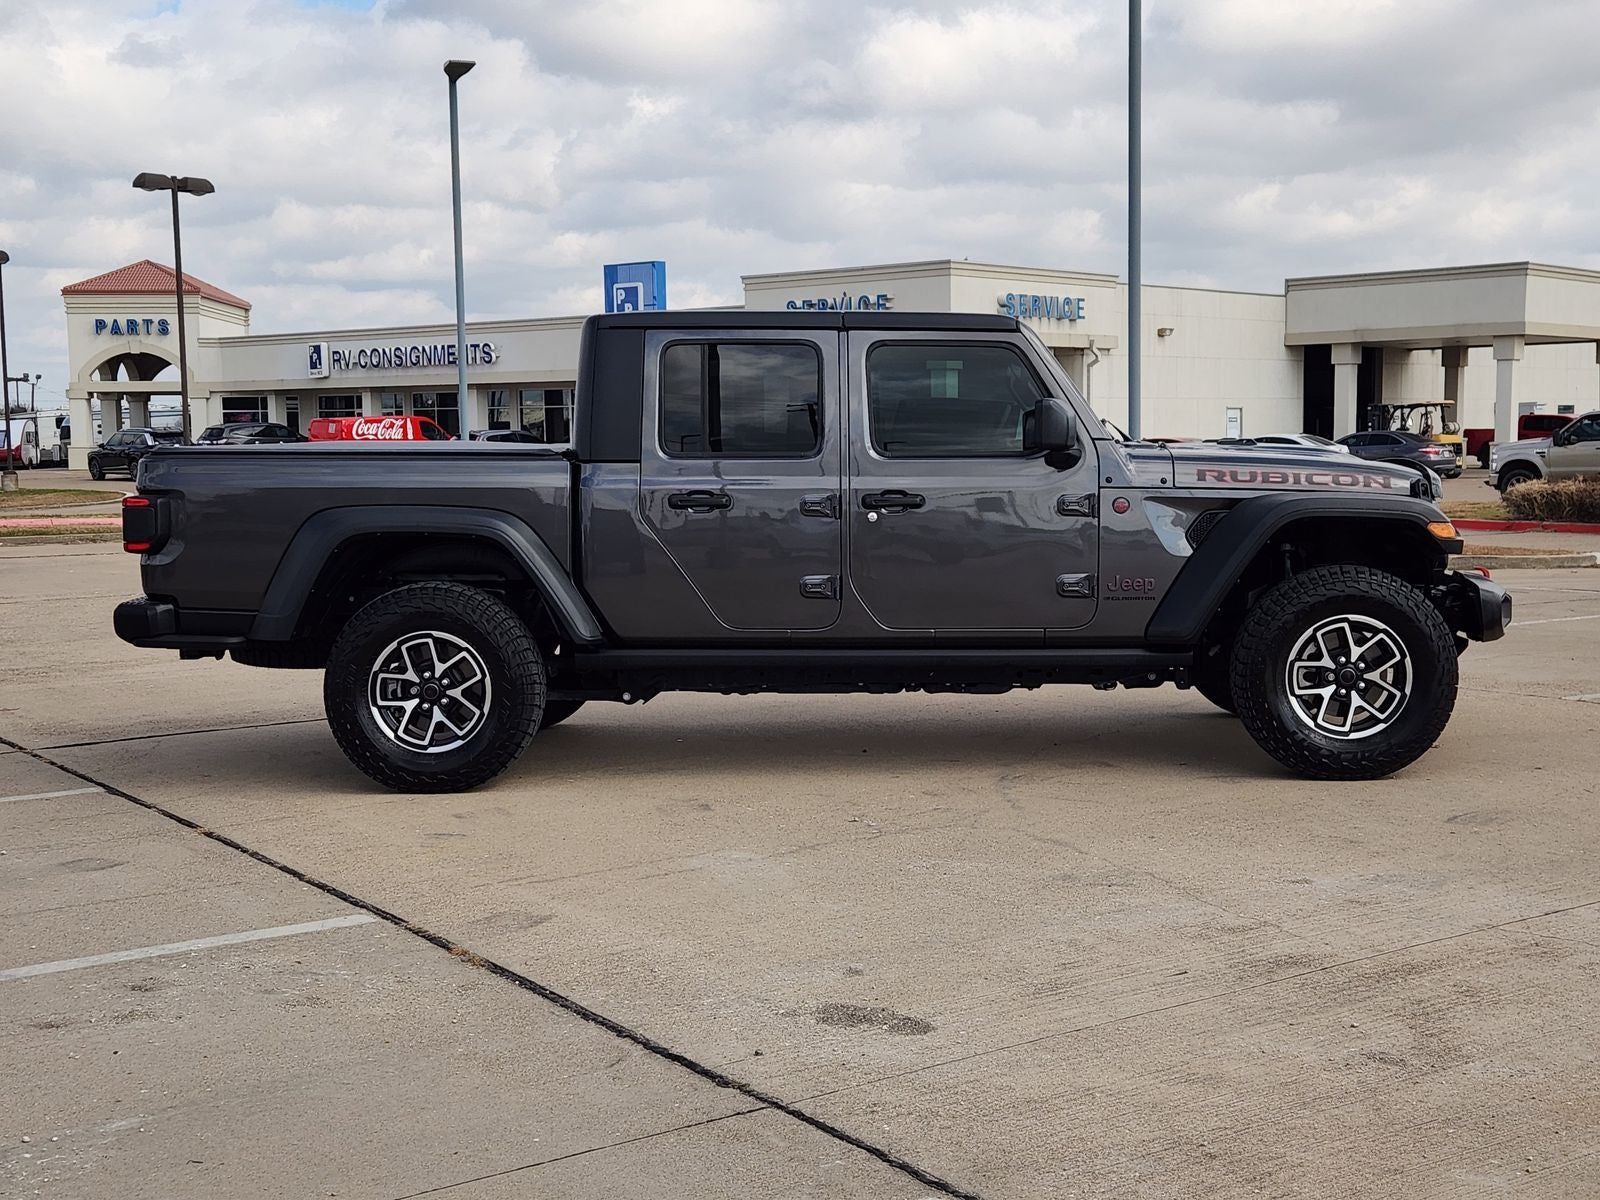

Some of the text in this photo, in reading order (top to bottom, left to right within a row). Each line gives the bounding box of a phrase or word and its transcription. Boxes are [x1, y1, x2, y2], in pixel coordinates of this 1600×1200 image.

[1005, 292, 1086, 320] SERVICE
[94, 318, 171, 336] PARTS
[332, 350, 352, 371] RV
[352, 418, 406, 440] Coca-Cola
[1196, 468, 1393, 490] RUBICON
[1106, 575, 1156, 595] Jeep
